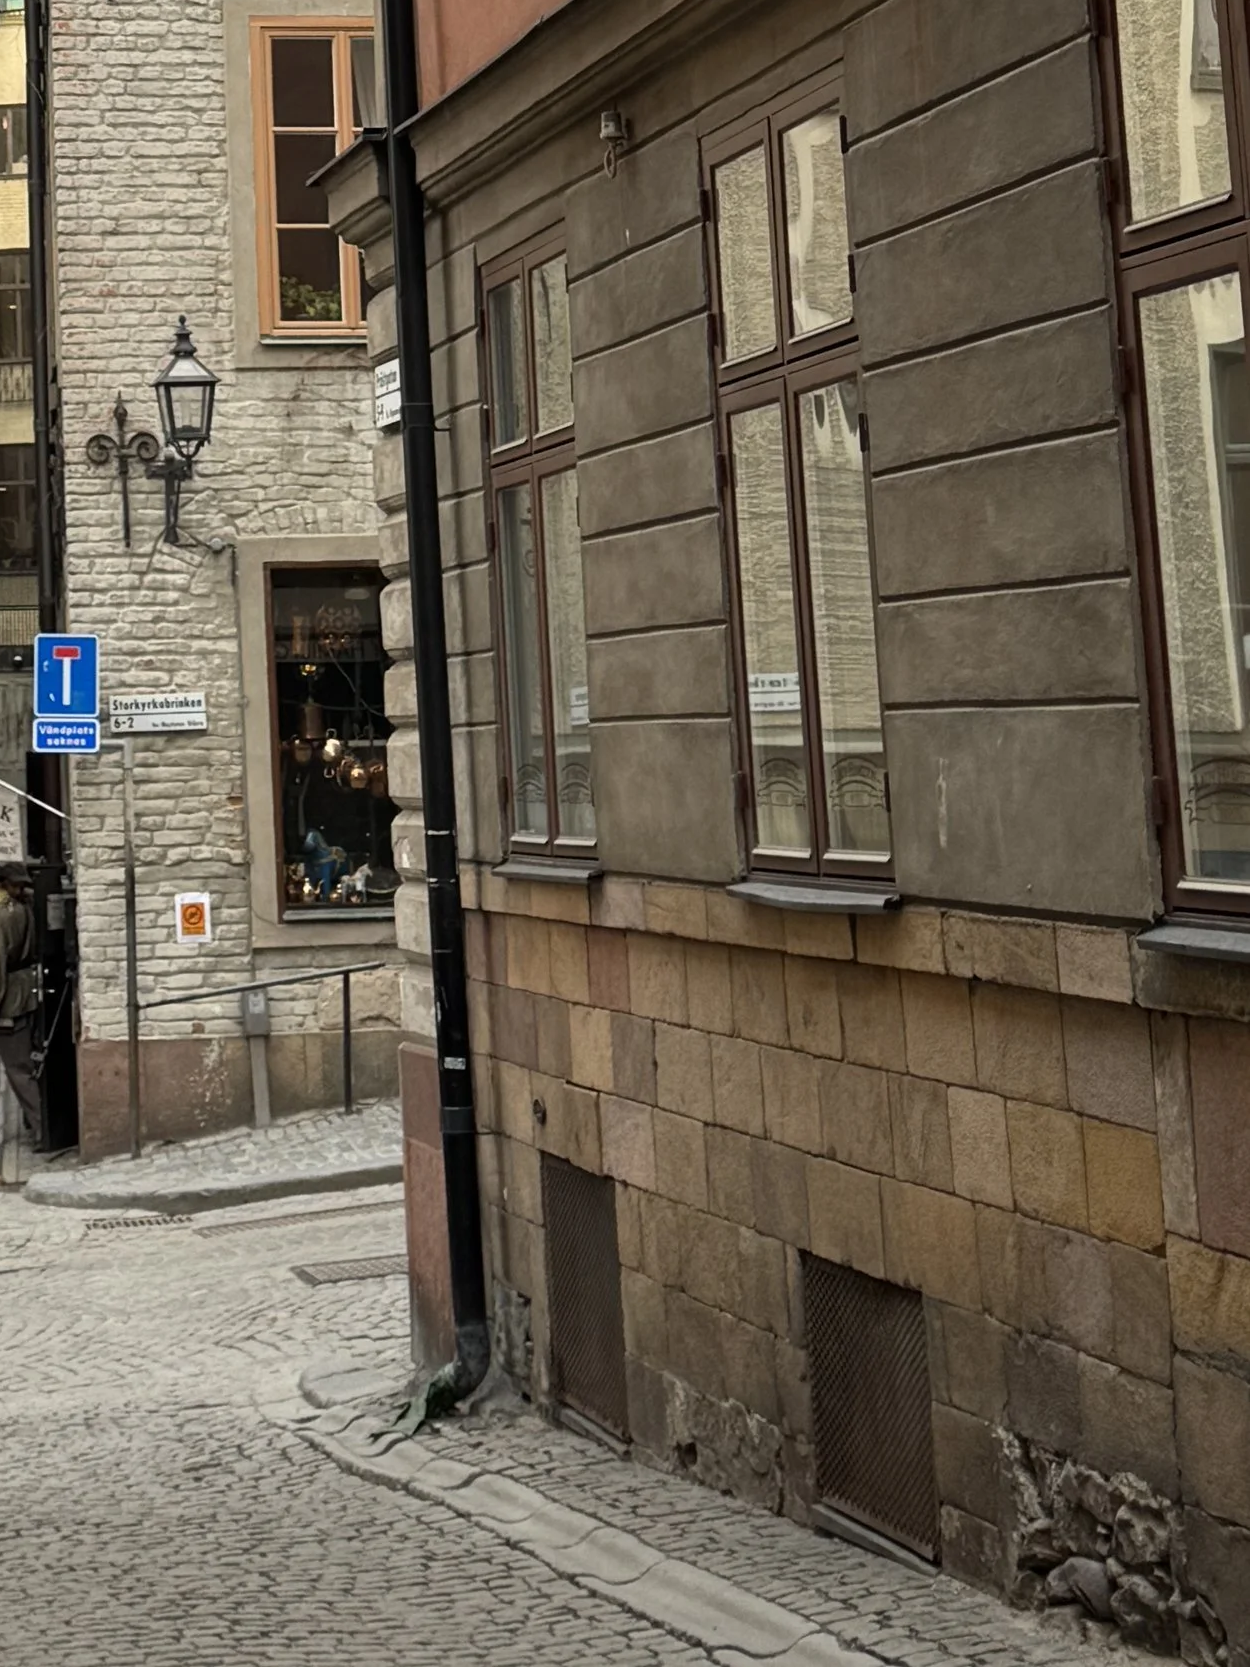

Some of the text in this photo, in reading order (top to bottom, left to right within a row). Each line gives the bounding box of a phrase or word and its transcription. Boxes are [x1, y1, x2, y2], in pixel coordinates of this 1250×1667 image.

[112, 697, 202, 711] Storkyrkobrinken
[114, 717, 135, 729] 6-2
[38, 725, 95, 736] Vändplats
[46, 736, 87, 746] saknas
